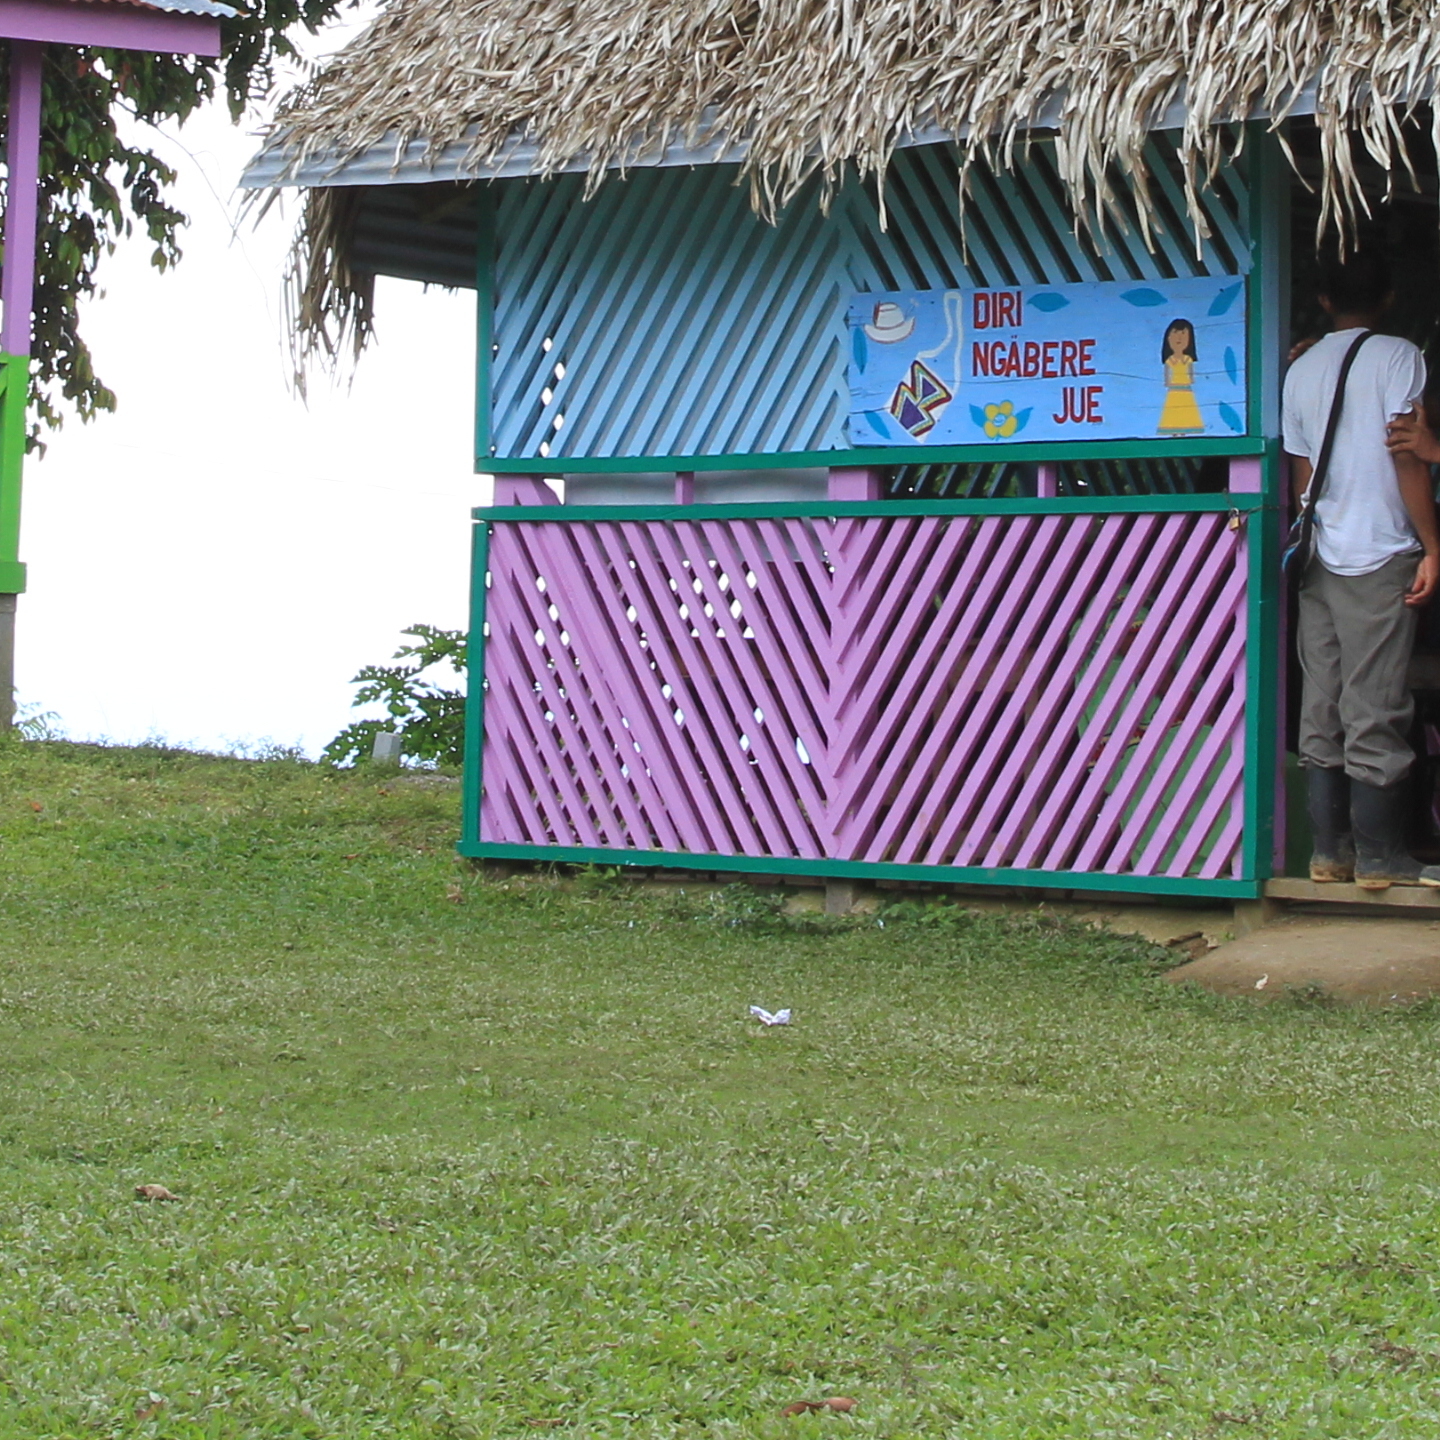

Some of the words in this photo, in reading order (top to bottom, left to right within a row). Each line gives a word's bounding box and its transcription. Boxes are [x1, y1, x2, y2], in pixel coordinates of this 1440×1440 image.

[973, 291, 1022, 329] DIRI
[972, 335, 1096, 378] NGÄBERE
[1052, 386, 1104, 424] JUE
